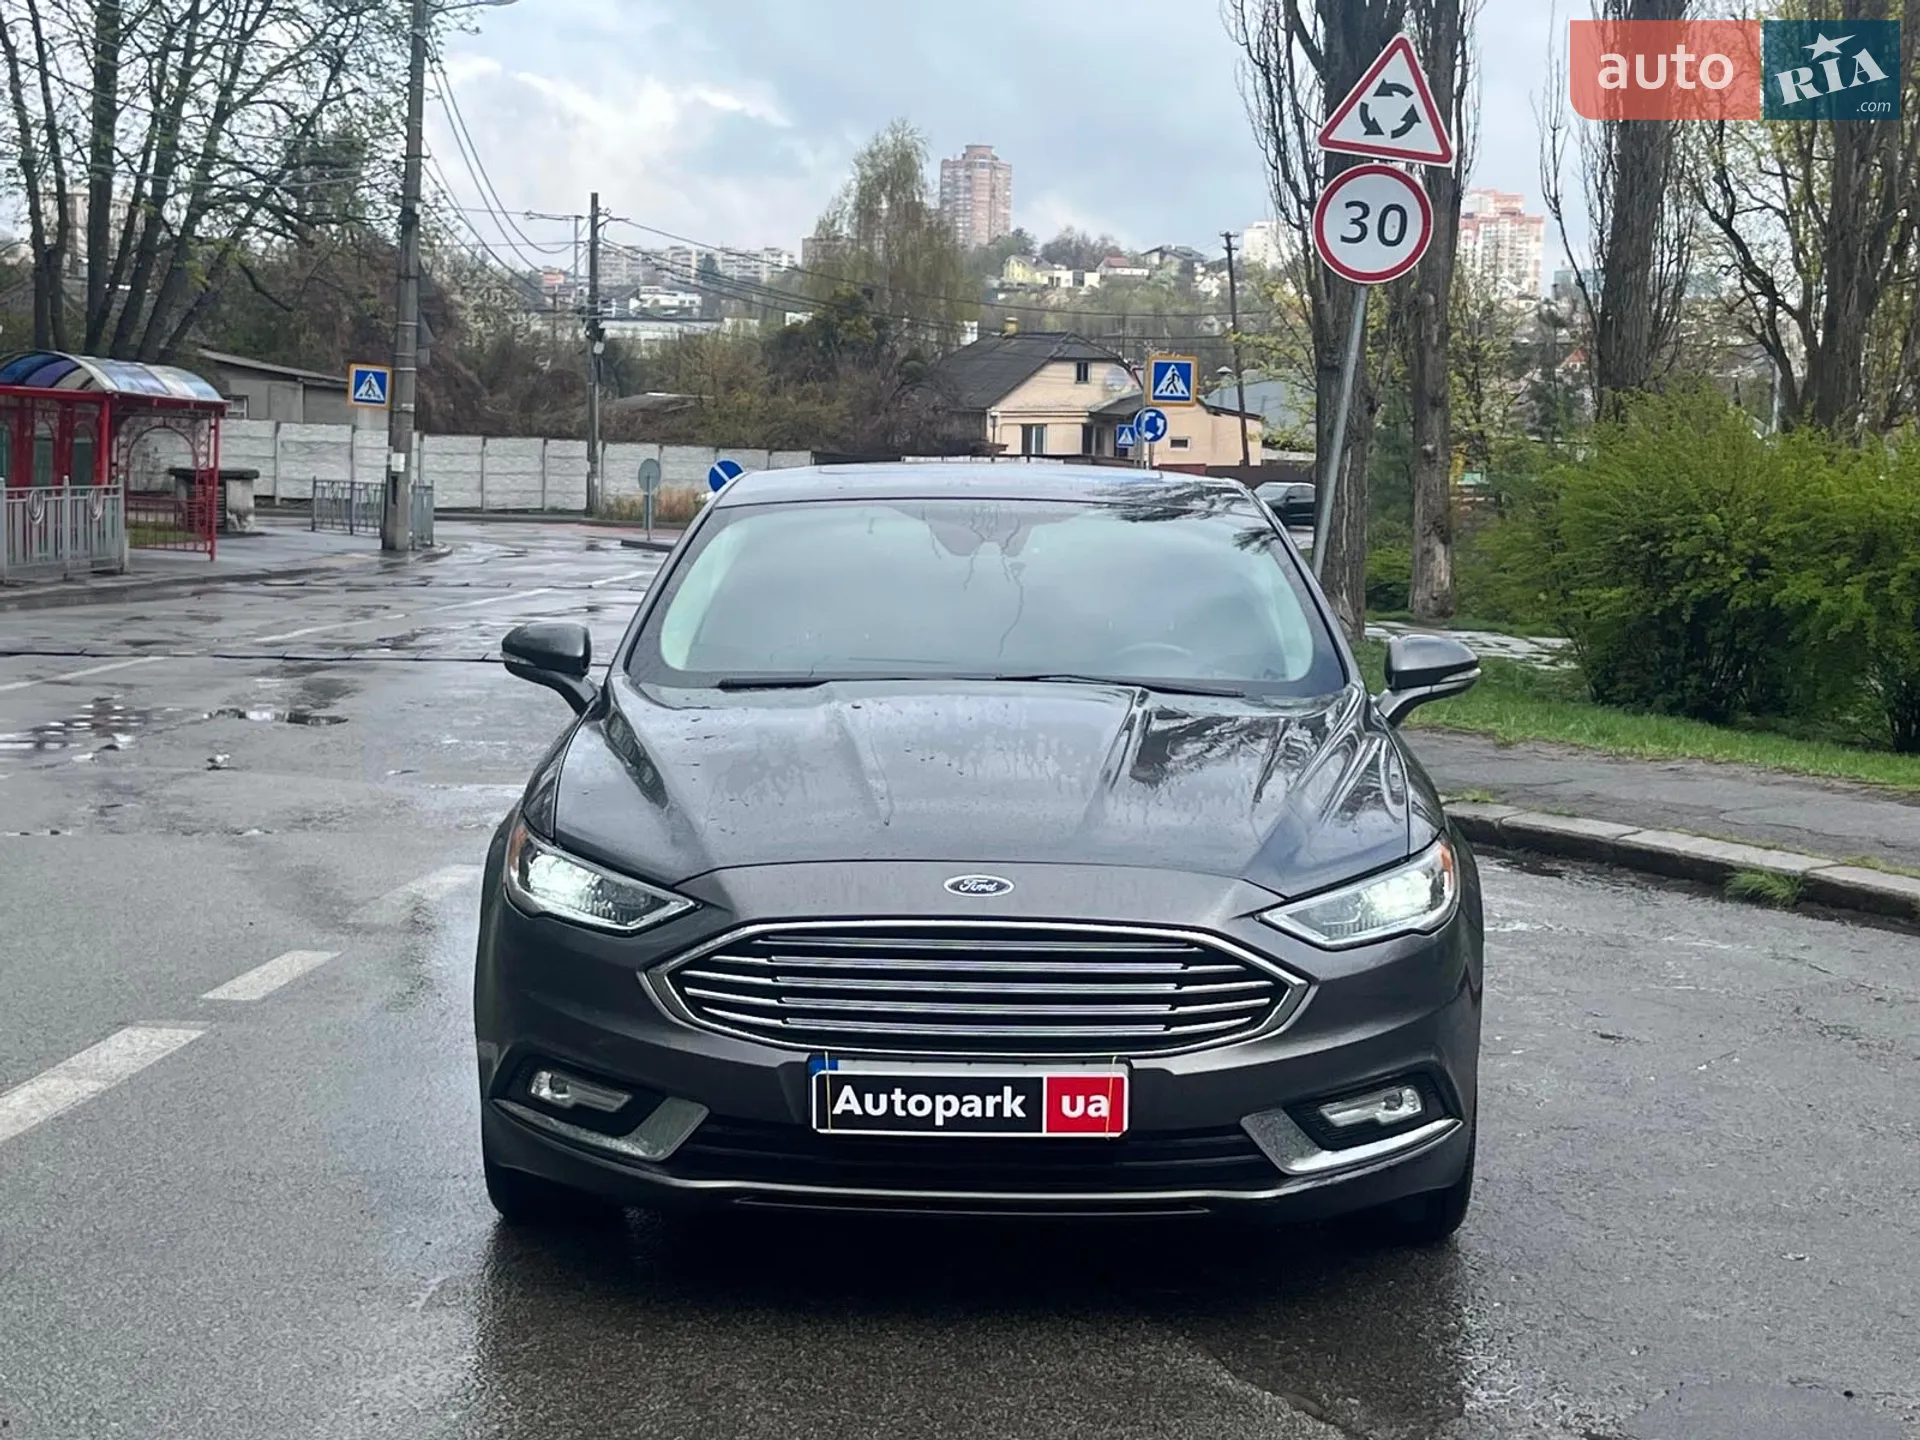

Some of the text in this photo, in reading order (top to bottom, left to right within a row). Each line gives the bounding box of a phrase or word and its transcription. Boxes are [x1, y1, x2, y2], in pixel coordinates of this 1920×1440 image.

[1339, 201, 1408, 247] 30
[959, 878, 997, 892] Ford
[832, 1085, 1110, 1126] Autopark ua
